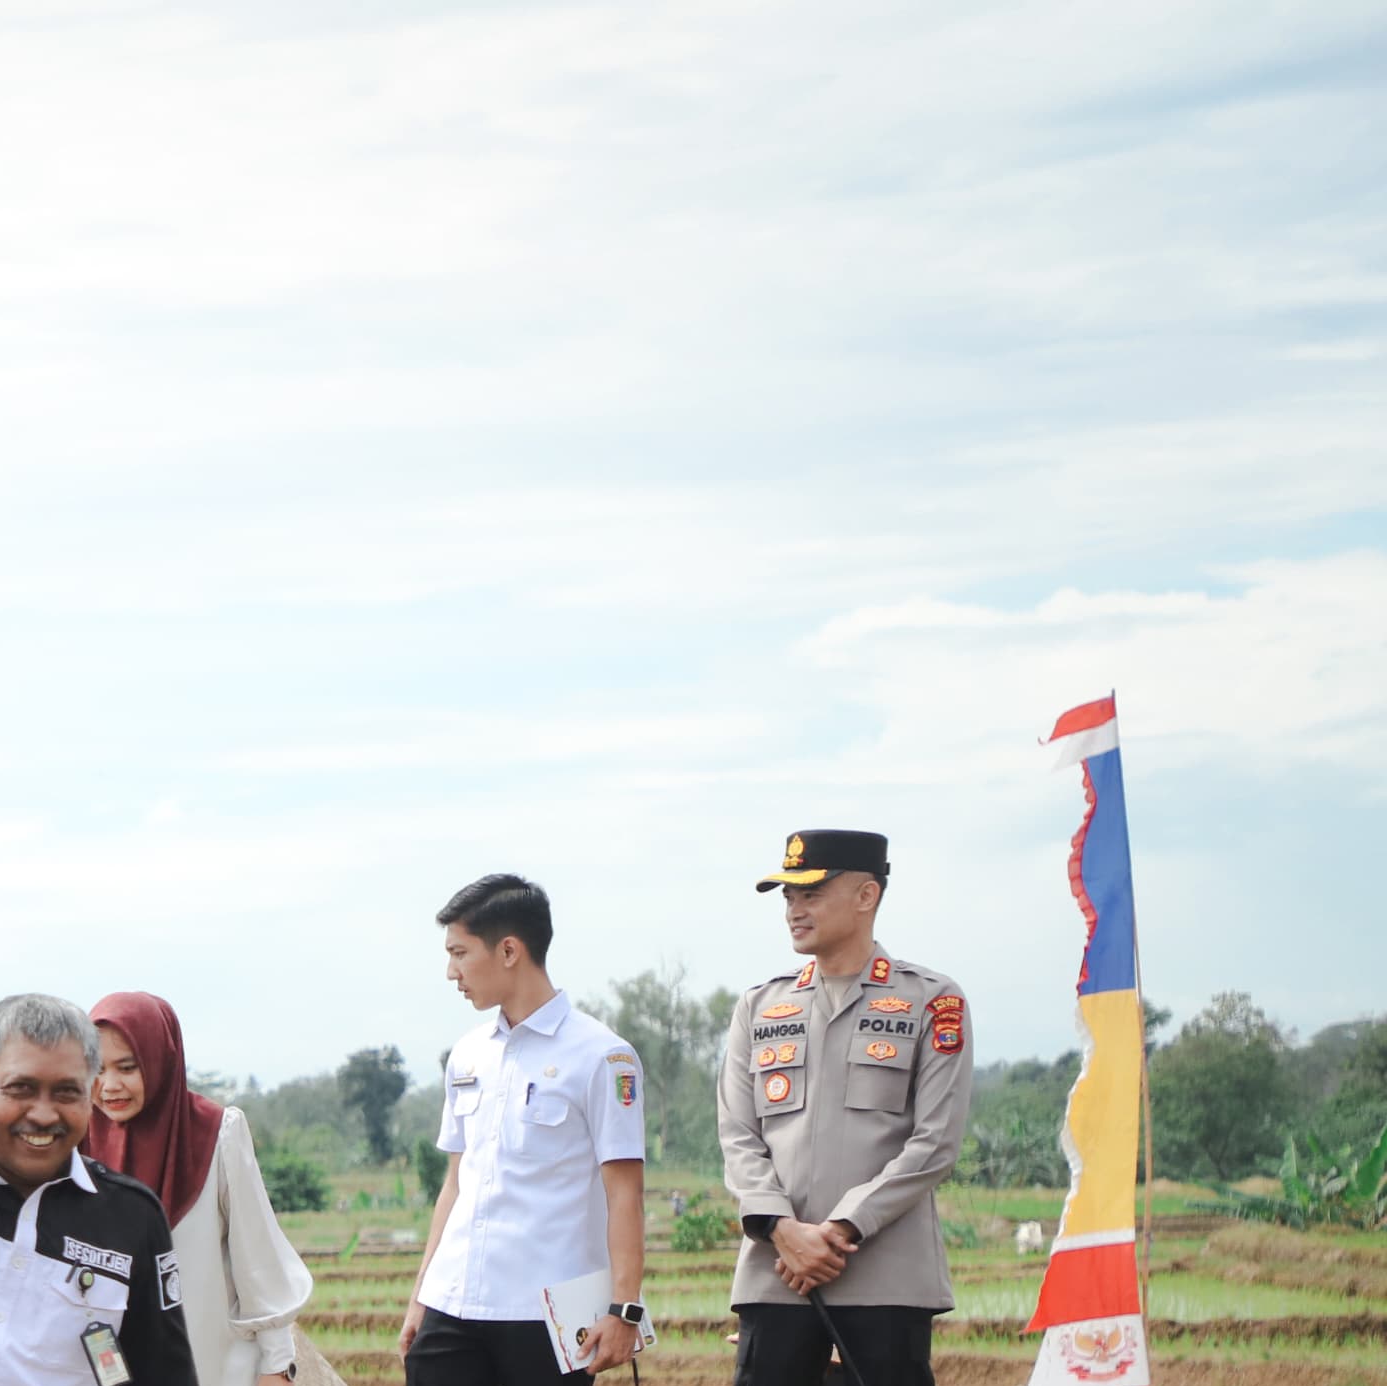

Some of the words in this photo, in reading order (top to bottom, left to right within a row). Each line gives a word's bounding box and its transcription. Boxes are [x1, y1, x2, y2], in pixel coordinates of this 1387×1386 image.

[753, 1022, 806, 1041] HANGGA
[858, 1018, 914, 1036] POLRI
[68, 1241, 127, 1272] SESDITJEN
